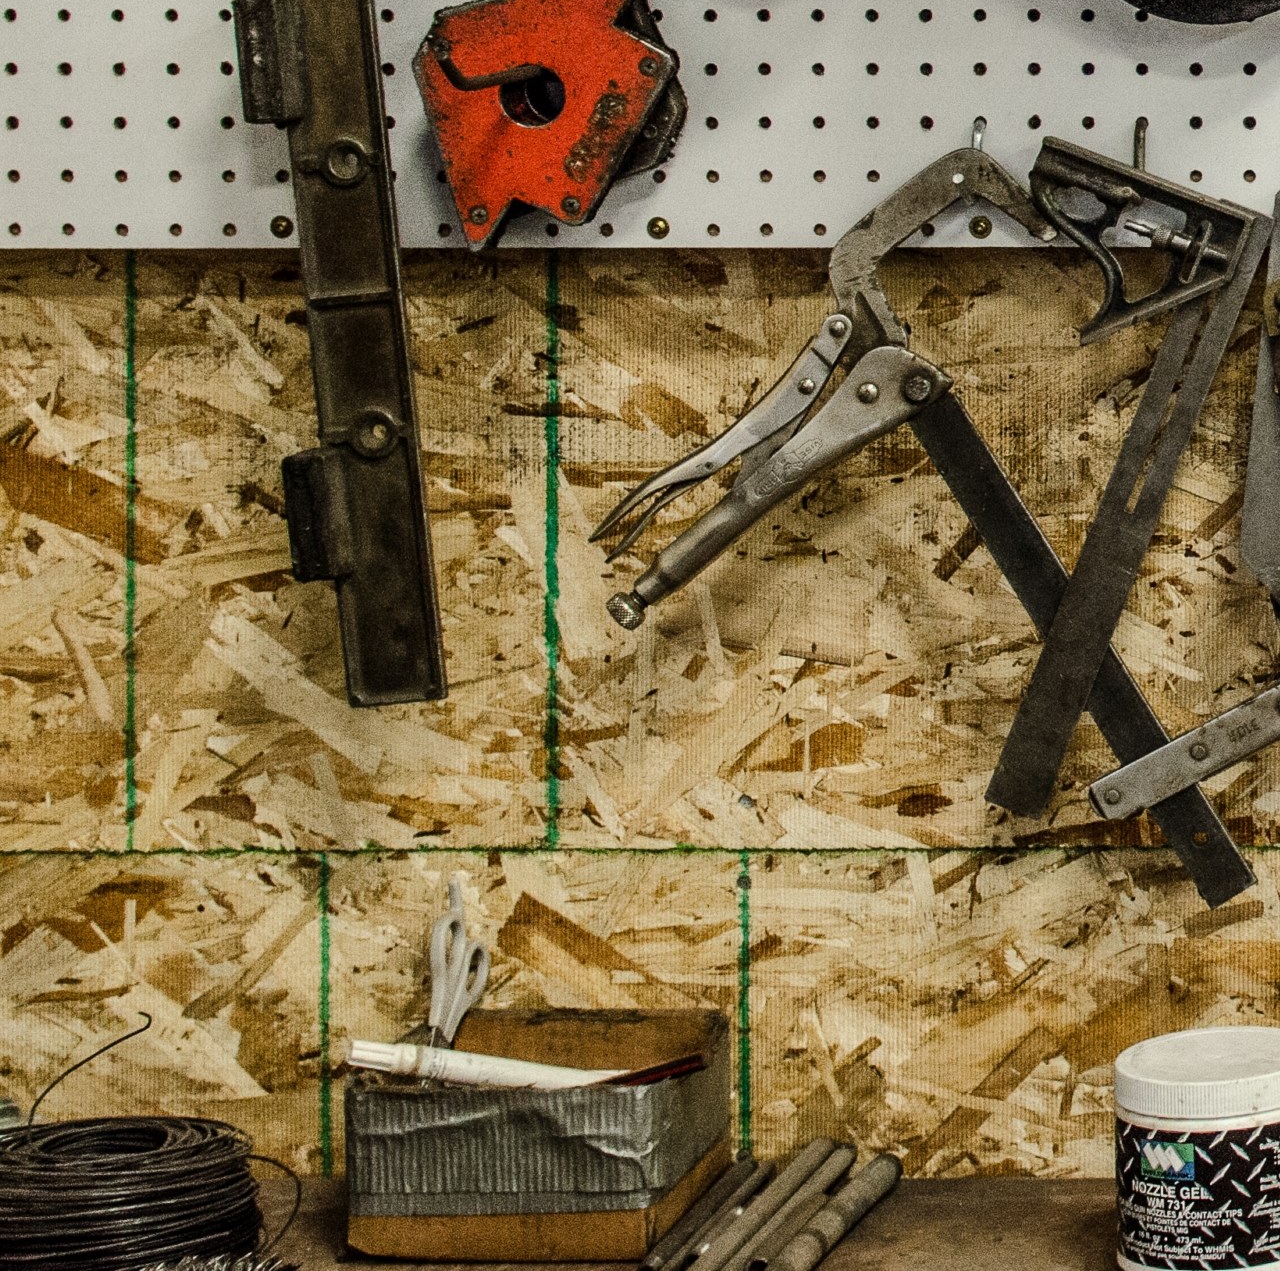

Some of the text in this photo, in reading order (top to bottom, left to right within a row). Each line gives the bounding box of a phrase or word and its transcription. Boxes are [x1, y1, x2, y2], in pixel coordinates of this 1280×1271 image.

[1131, 1180, 1209, 1200] NOZZLE GEL
[1146, 1196, 1165, 1209] WM
[1167, 1200, 1186, 1210] 731
[1147, 1208, 1177, 1219] NOZZLES
[1185, 1210, 1223, 1220] CONTACT
[1225, 1208, 1243, 1218] TIPS
[1189, 1218, 1221, 1227] CONTACT
[1176, 1236, 1189, 1244] 473
[1193, 1246, 1203, 1254] To
[1204, 1244, 1235, 1253] WHMIS
